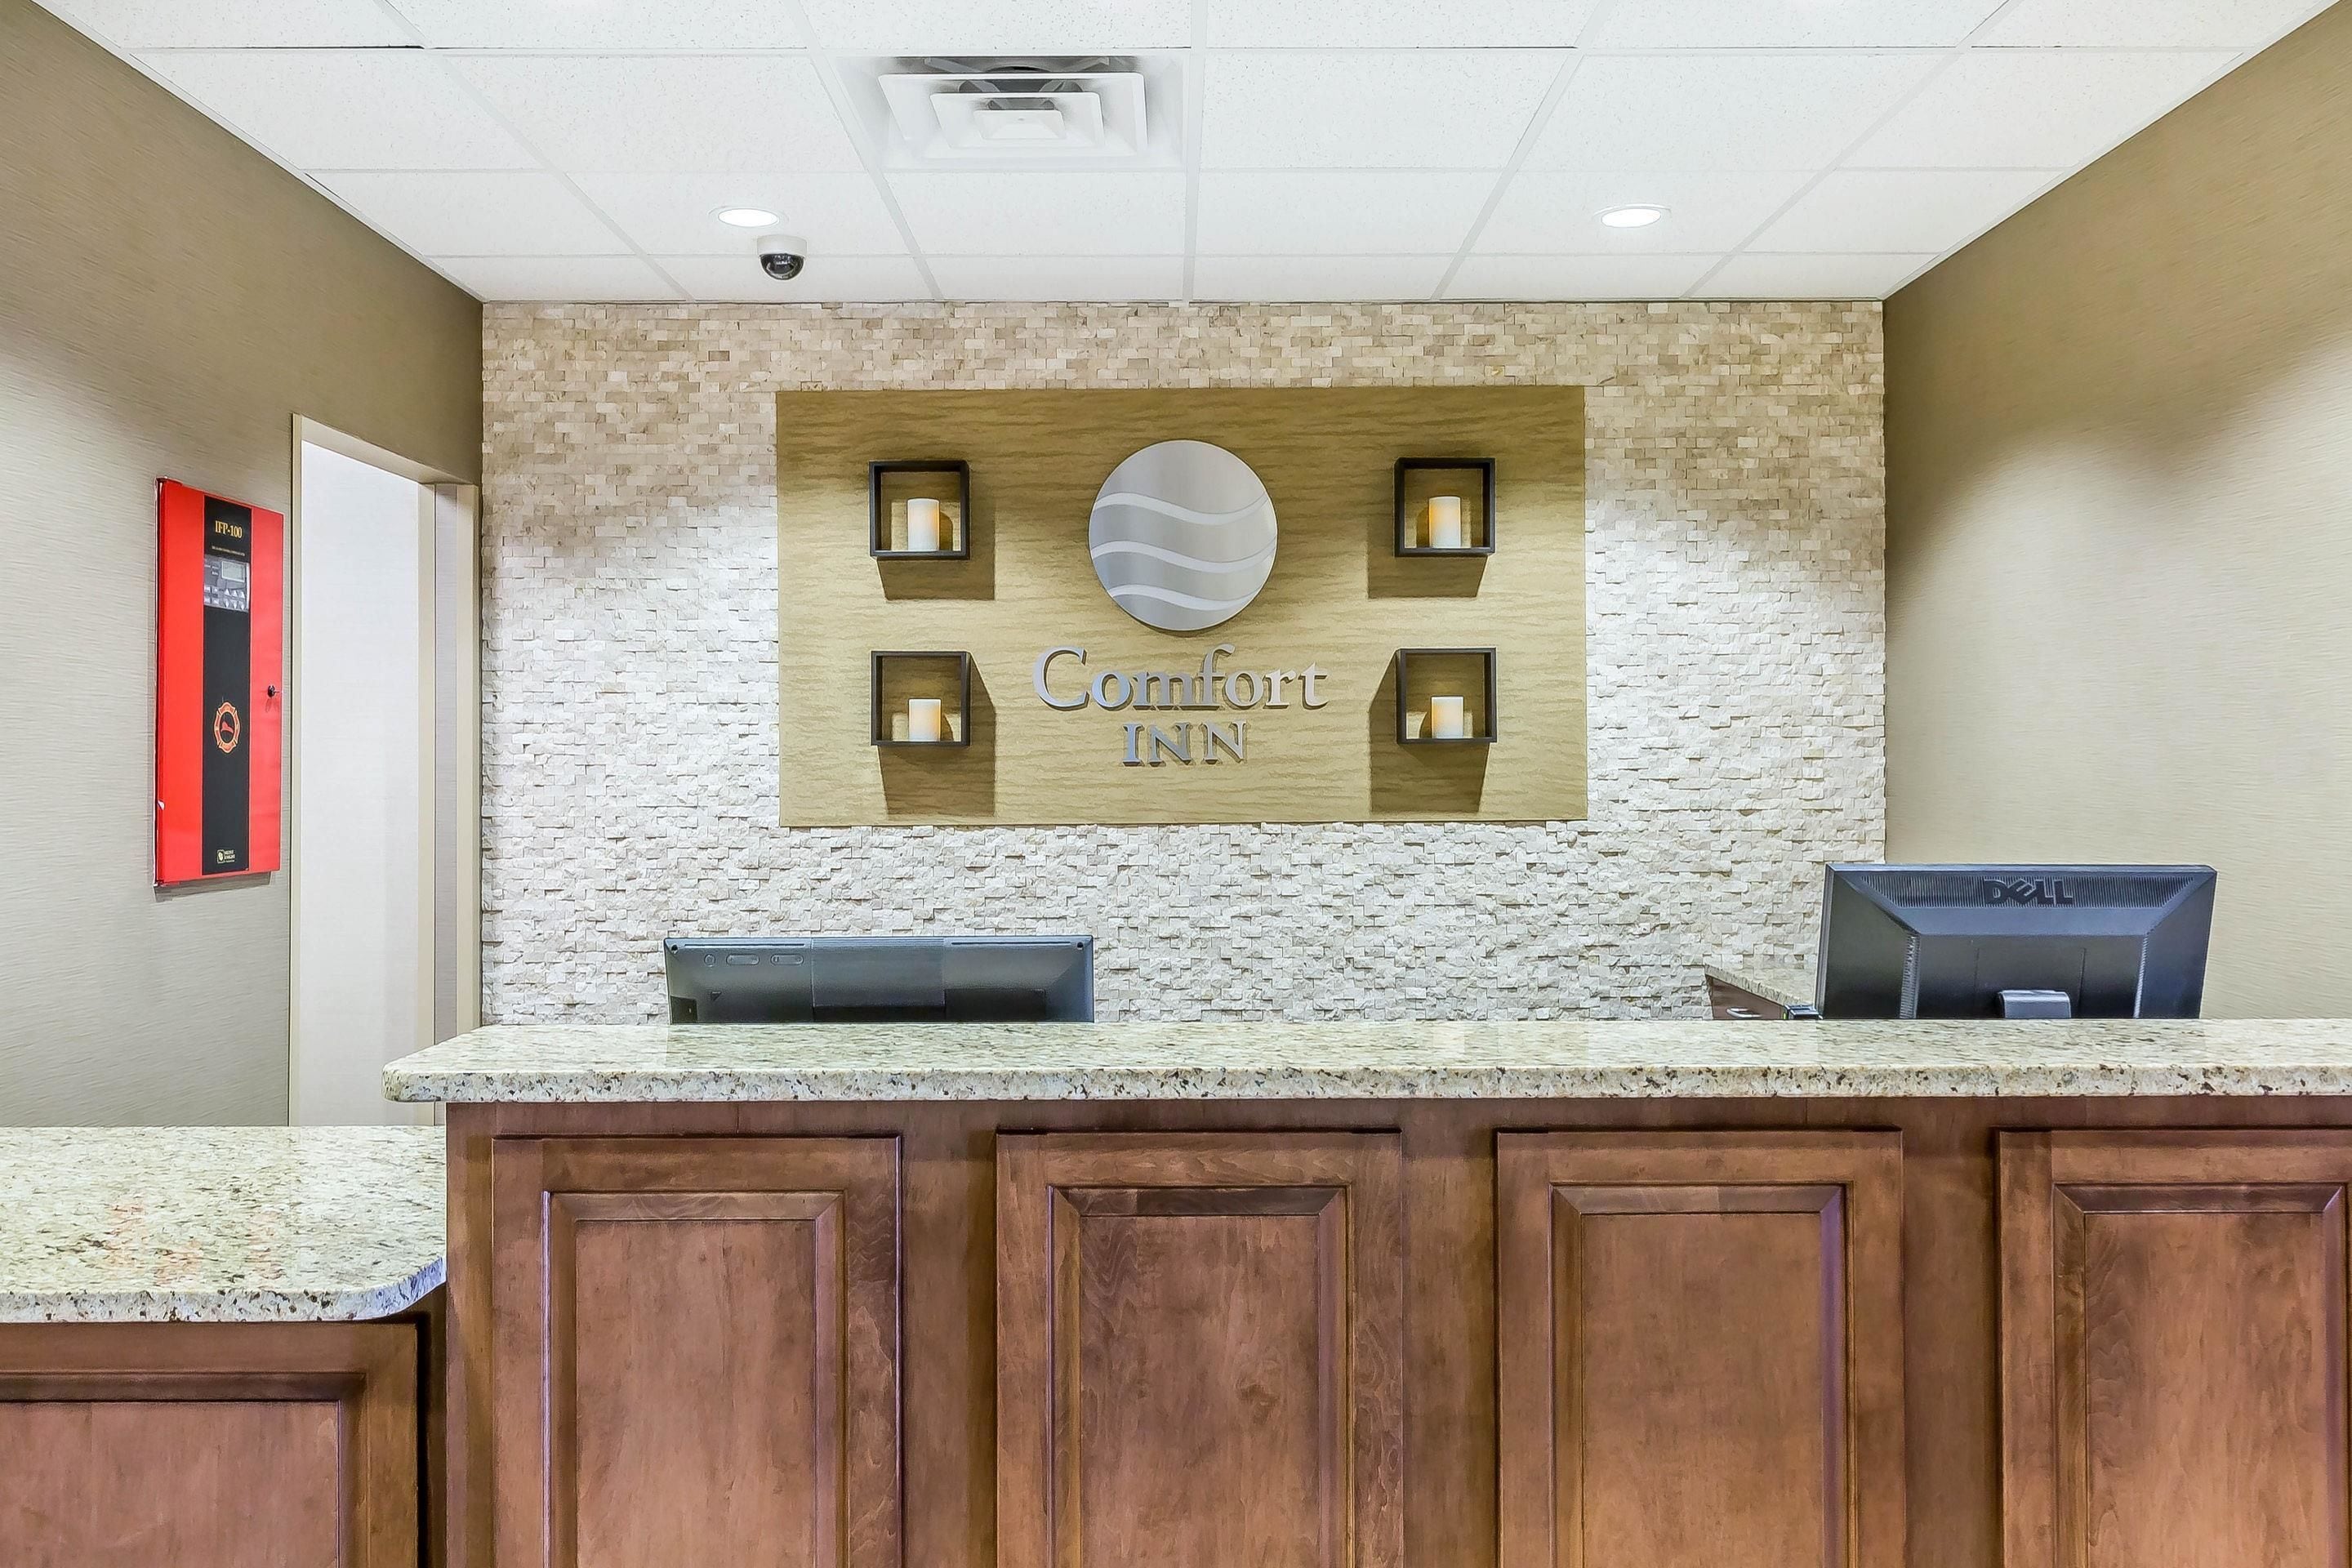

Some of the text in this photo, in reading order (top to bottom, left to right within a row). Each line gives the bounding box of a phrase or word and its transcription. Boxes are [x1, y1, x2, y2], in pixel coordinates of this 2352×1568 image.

[215, 520, 243, 539] IFP-100
[1033, 644, 1331, 710] Comfort
[1122, 720, 1248, 768] INN
[1984, 879, 2074, 905] DELL
